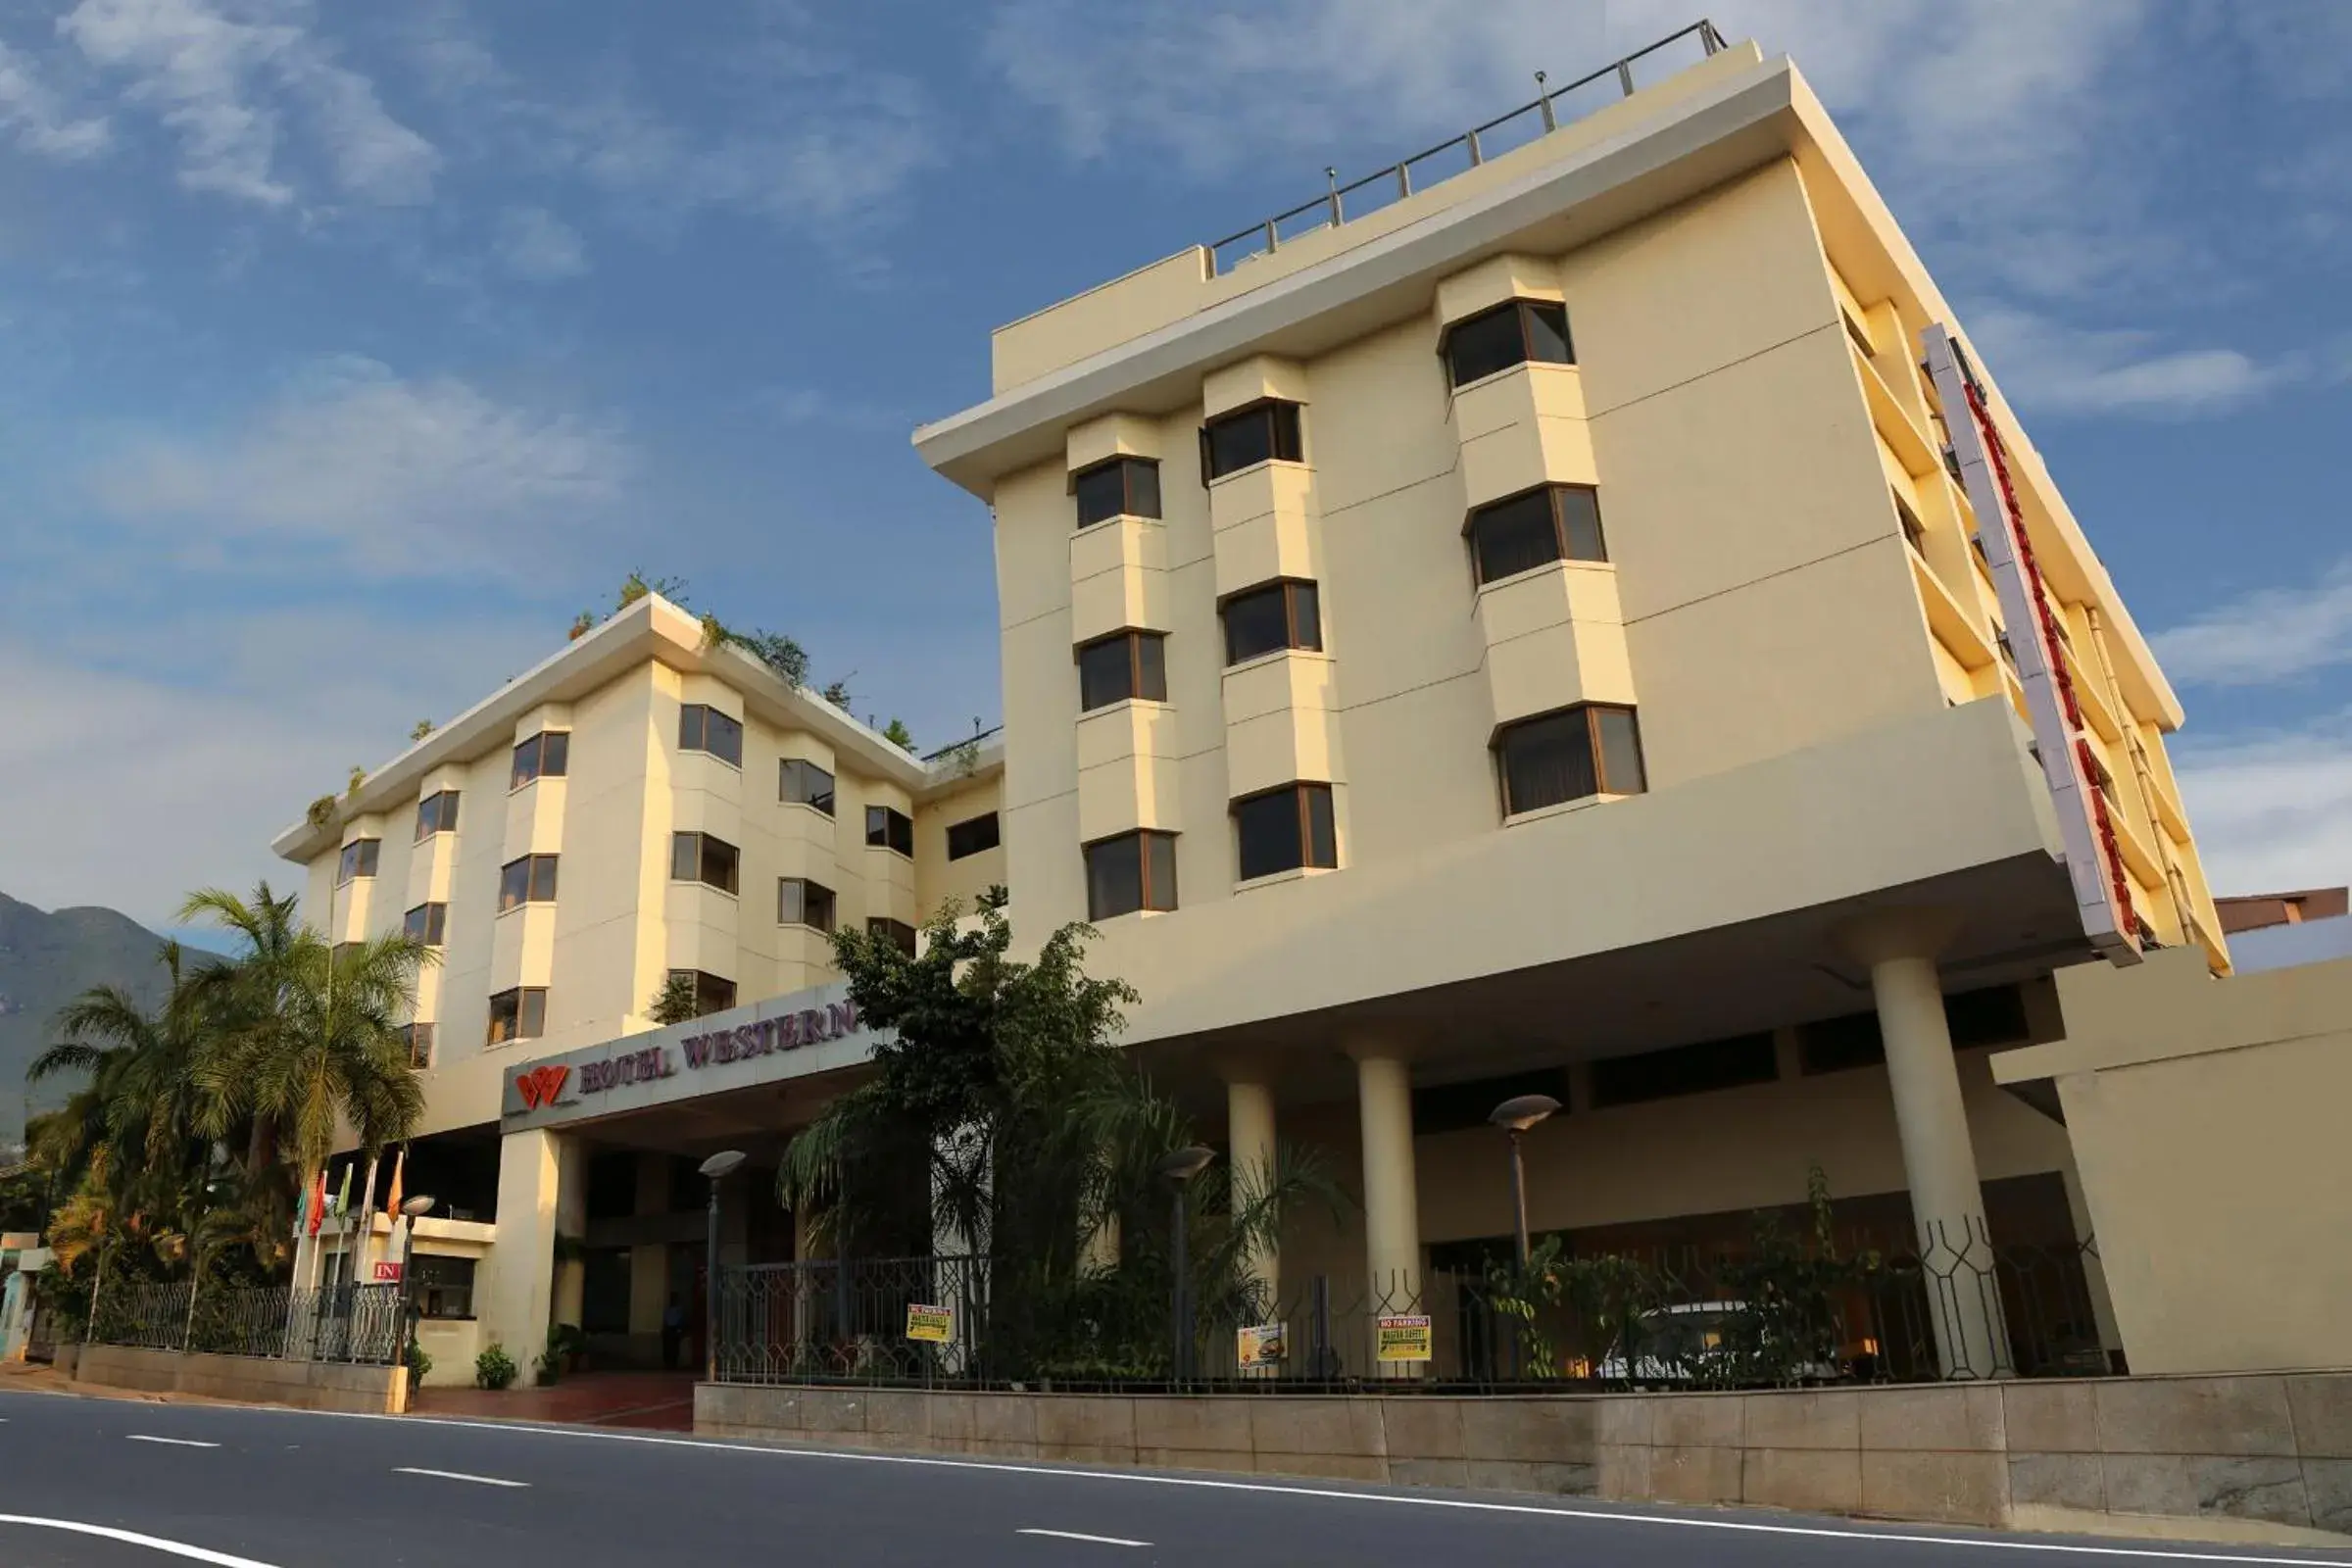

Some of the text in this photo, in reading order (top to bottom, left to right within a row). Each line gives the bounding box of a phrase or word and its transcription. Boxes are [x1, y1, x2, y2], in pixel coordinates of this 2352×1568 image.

[578, 998, 859, 1095] HOTEL WESTERN
[376, 1263, 395, 1277] IN
